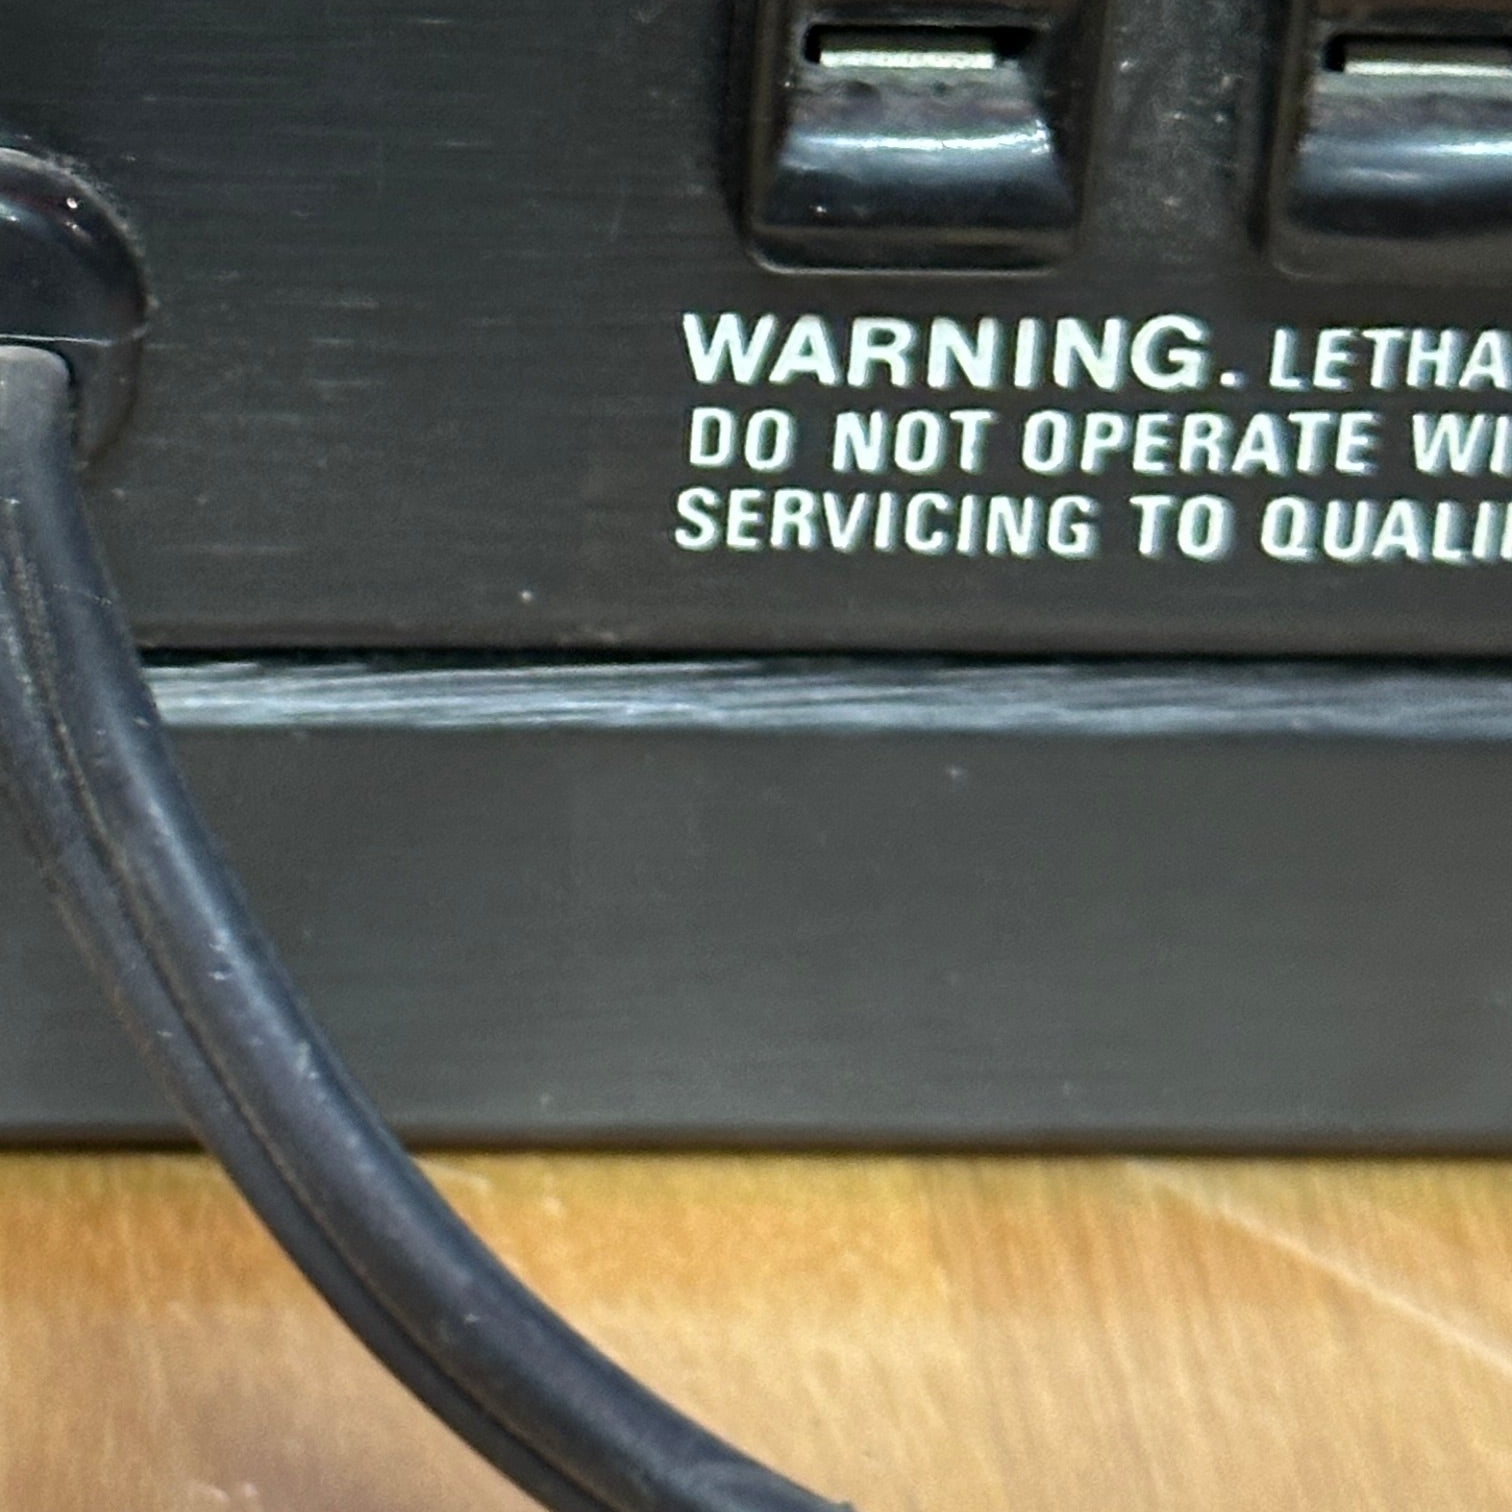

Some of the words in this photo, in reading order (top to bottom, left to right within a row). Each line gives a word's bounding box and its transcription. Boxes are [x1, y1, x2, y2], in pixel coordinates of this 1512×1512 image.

[681, 312, 1244, 392] WARNING.
[688, 405, 795, 473] DO
[831, 408, 996, 475] NOT
[1020, 409, 1378, 476] OPERATE
[673, 486, 1098, 559] SERVICING
[1128, 493, 1234, 561] TO
[1259, 495, 1512, 565] QUALI
